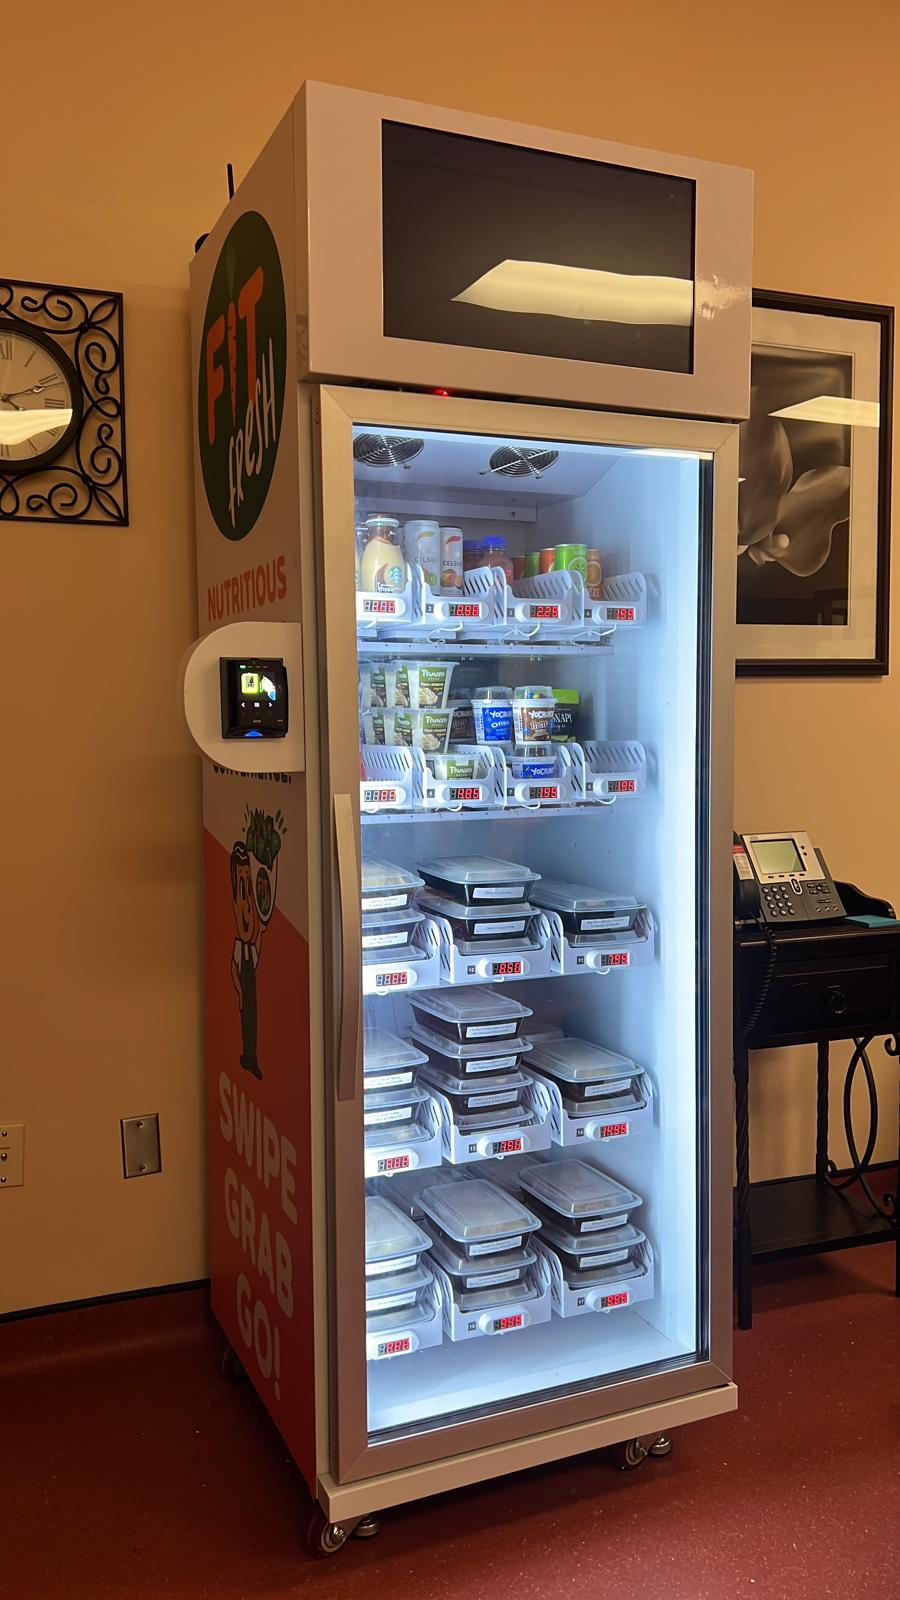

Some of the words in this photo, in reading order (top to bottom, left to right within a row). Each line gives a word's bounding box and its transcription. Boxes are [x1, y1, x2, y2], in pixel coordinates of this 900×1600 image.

[206, 266, 264, 445] FIT
[207, 555, 287, 621] NUTRITIOUS
[218, 1071, 298, 1225] SWIPE
[224, 1167, 295, 1319] GRAB
[236, 1272, 282, 1401] GO!
